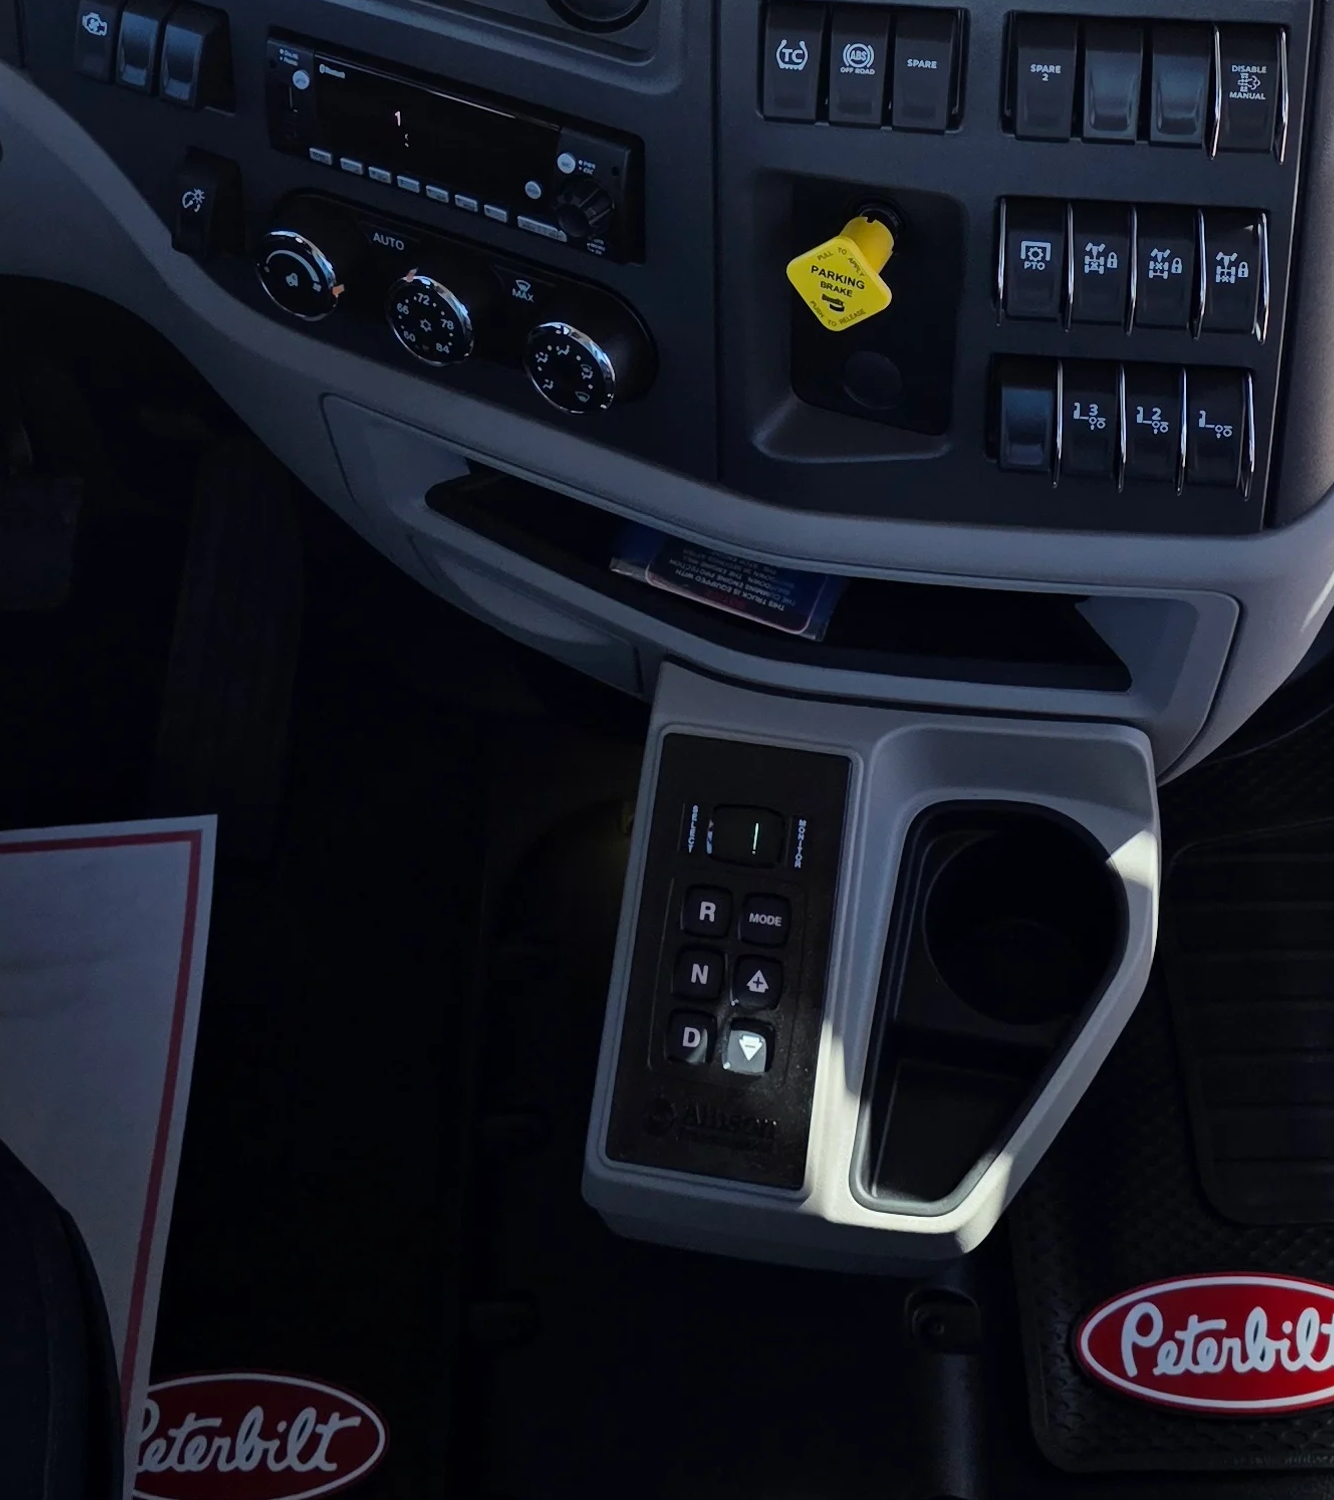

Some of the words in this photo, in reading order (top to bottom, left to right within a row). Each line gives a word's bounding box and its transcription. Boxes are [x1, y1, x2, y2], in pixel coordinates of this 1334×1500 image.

[782, 48, 804, 64] TC
[850, 49, 868, 62] ABS
[907, 58, 938, 69] SPARE
[1030, 63, 1062, 74] SPARE
[1231, 64, 1267, 74] DISABLE
[840, 66, 853, 75] OFF
[855, 67, 876, 76] ROAD
[1042, 73, 1049, 81] 2
[1229, 91, 1266, 101] MANUAL
[373, 232, 405, 251] AUTO
[816, 250, 834, 261] PULL
[837, 246, 847, 256] TO
[847, 257, 866, 277] APPLY
[1024, 261, 1046, 271] PTO
[810, 264, 866, 290] PARKING
[511, 288, 535, 303] MAX
[820, 280, 853, 298] BRAKE
[417, 292, 430, 306] 72
[397, 302, 409, 315] 66
[810, 300, 825, 318] PUSH
[827, 319, 837, 328] TO
[839, 308, 867, 325] RELEASE
[440, 318, 454, 330] 78
[404, 330, 416, 342] 60
[436, 342, 450, 354] 84
[1088, 403, 1099, 417] 3
[1152, 407, 1162, 420] 2
[675, 568, 694, 580] WITH
[694, 575, 732, 593] EQUIPPED
[742, 590, 767, 606] TRUCK
[768, 599, 785, 611] THIS
[687, 804, 699, 853] SELECT
[794, 819, 807, 869] MONITOR
[699, 901, 717, 923] R
[748, 912, 783, 928] MODE
[691, 963, 709, 985] N
[682, 1026, 702, 1048] D
